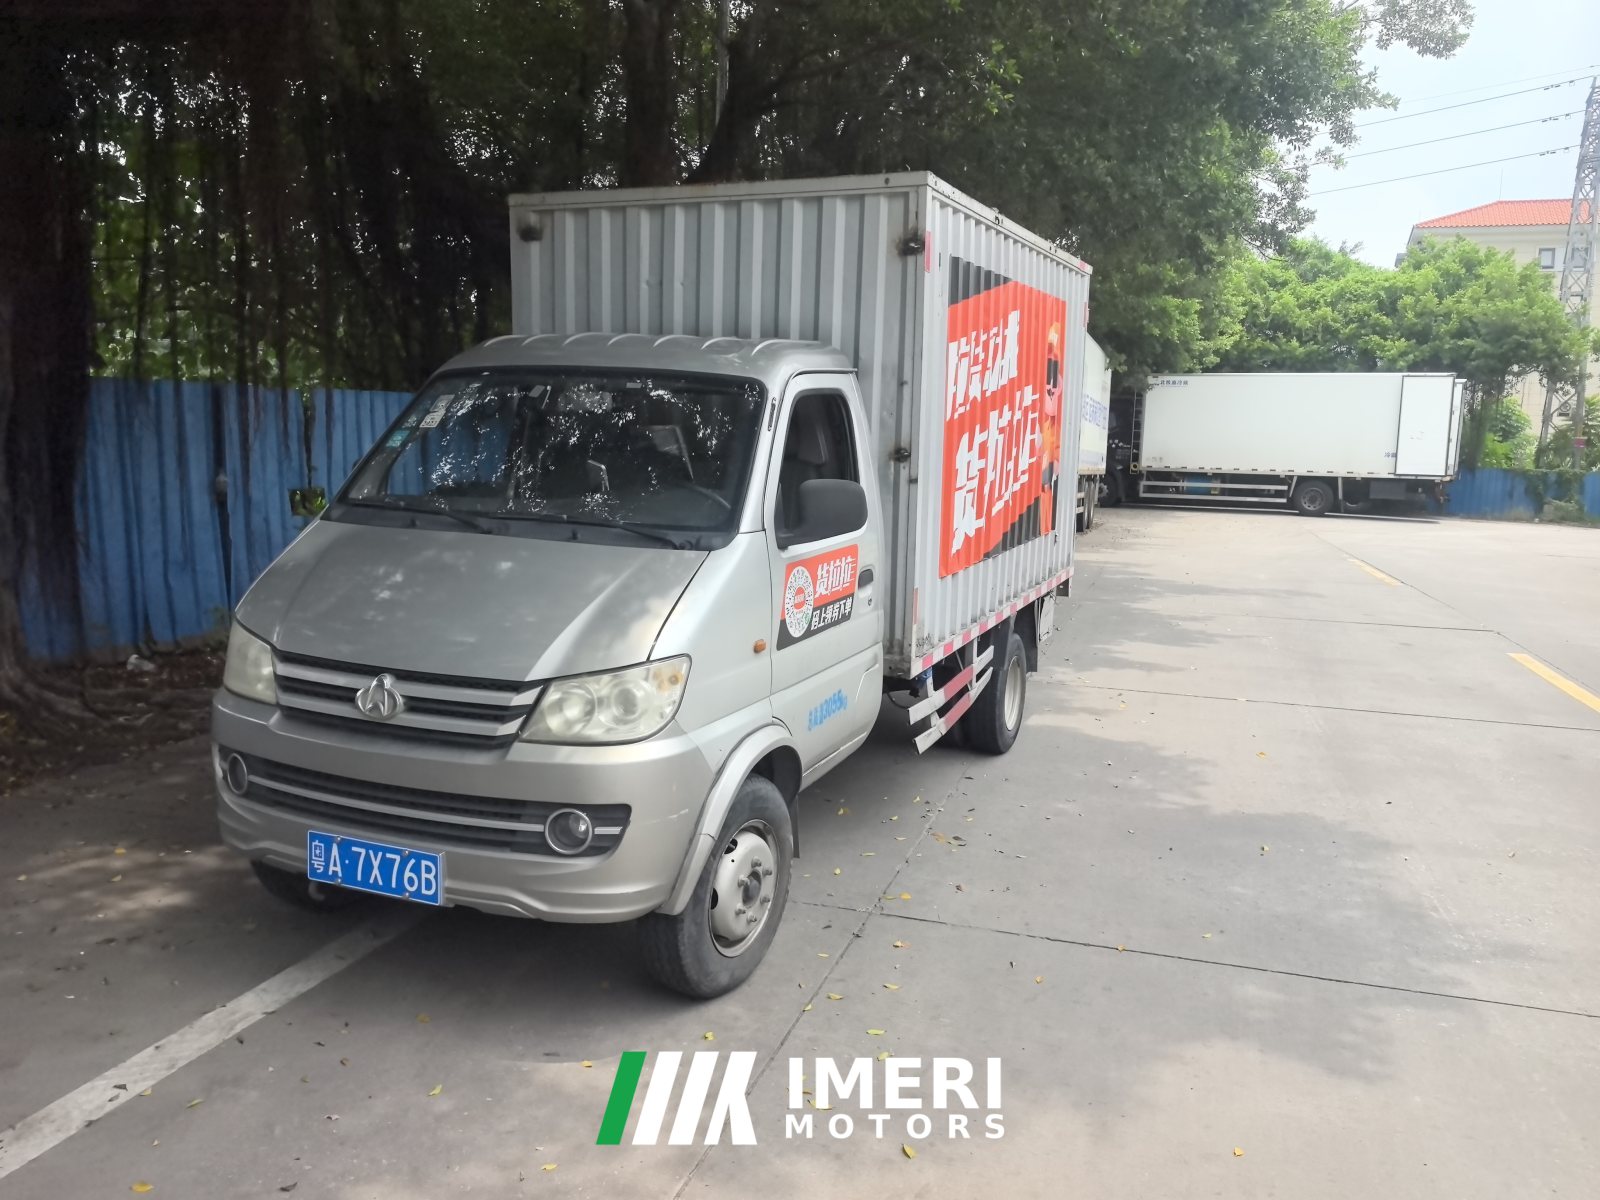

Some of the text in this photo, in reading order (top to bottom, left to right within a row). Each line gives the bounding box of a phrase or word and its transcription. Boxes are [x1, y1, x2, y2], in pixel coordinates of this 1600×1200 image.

[951, 384, 1040, 556] 货拉拉
[815, 556, 856, 598] 货拉拉
